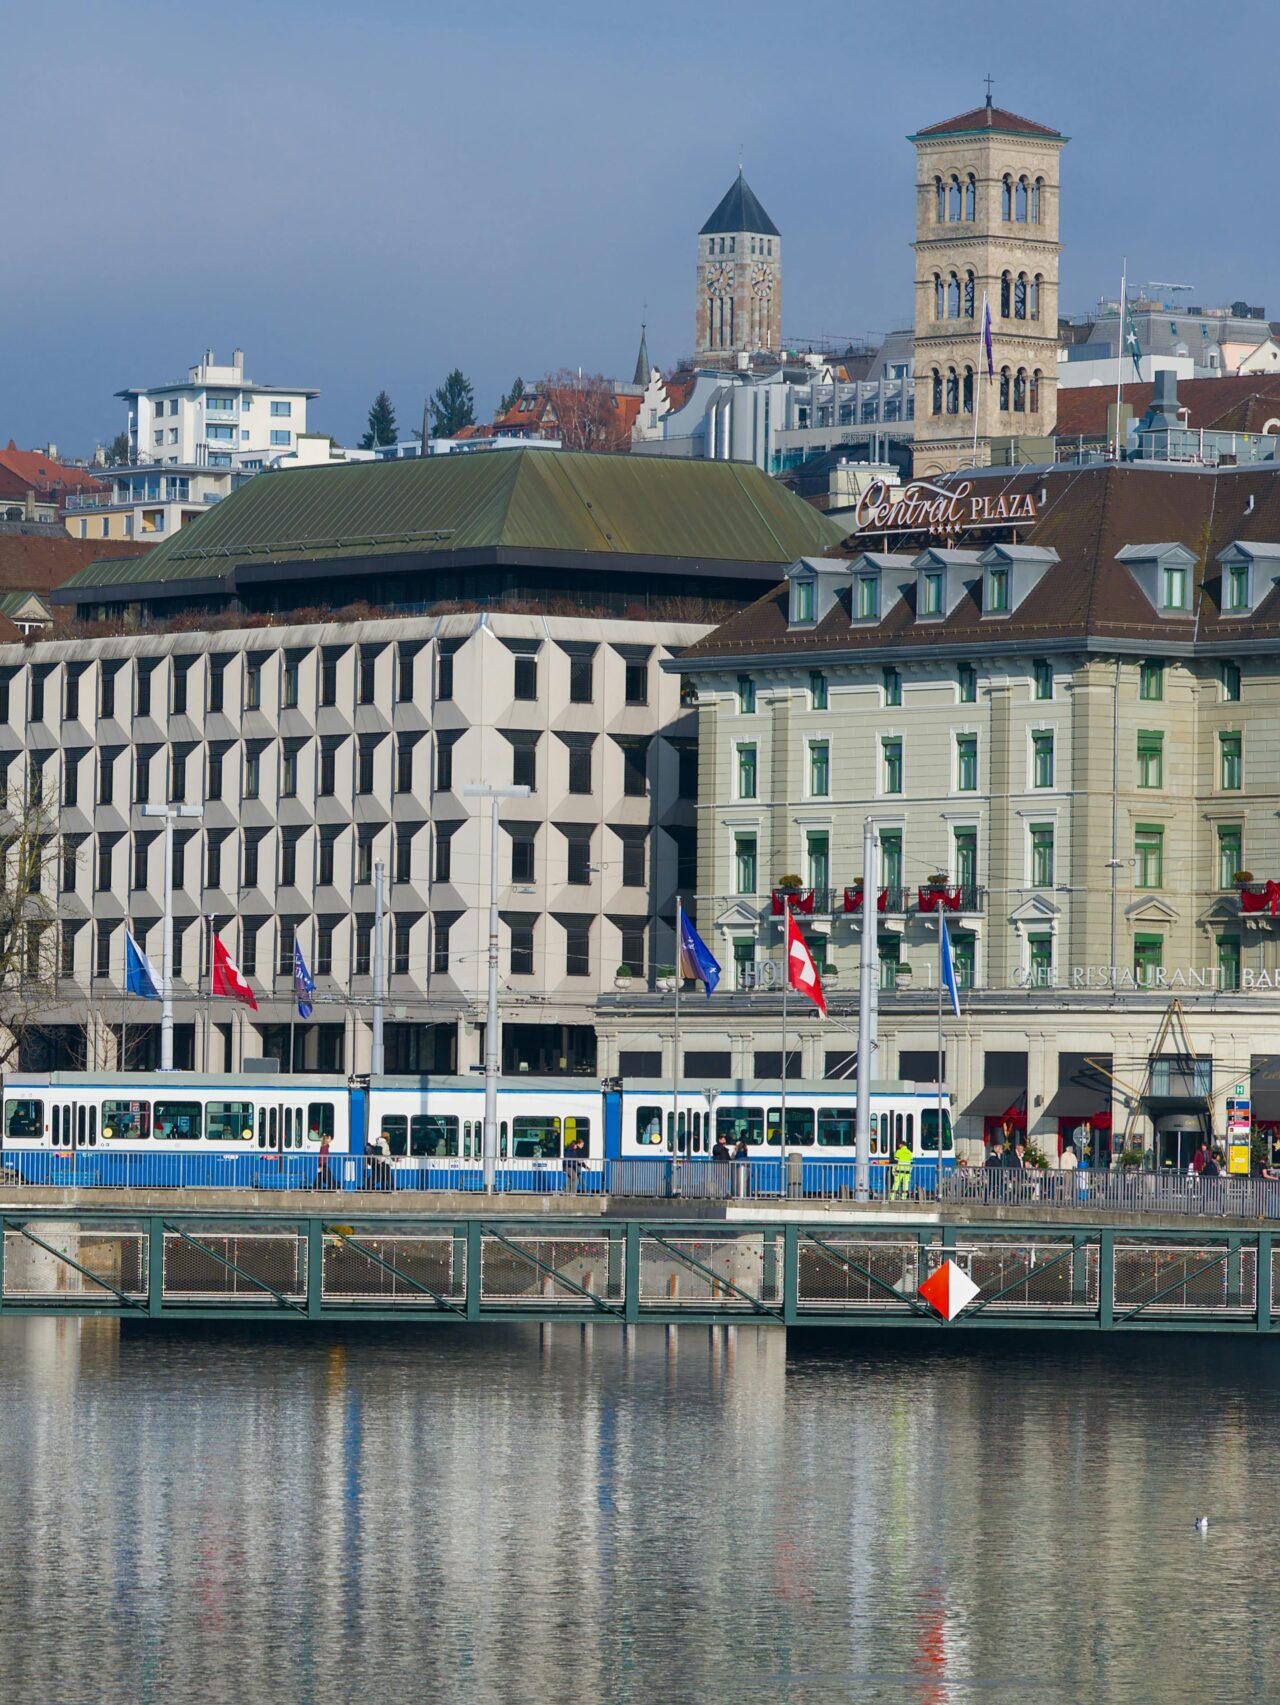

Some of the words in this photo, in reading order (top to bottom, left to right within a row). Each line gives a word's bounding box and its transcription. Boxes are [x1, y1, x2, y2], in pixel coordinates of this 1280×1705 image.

[855, 479, 972, 528] Central
[971, 493, 1036, 520] PLAZA
[1074, 966, 1222, 987] RESTAURANT
[158, 1106, 164, 1115] 7
